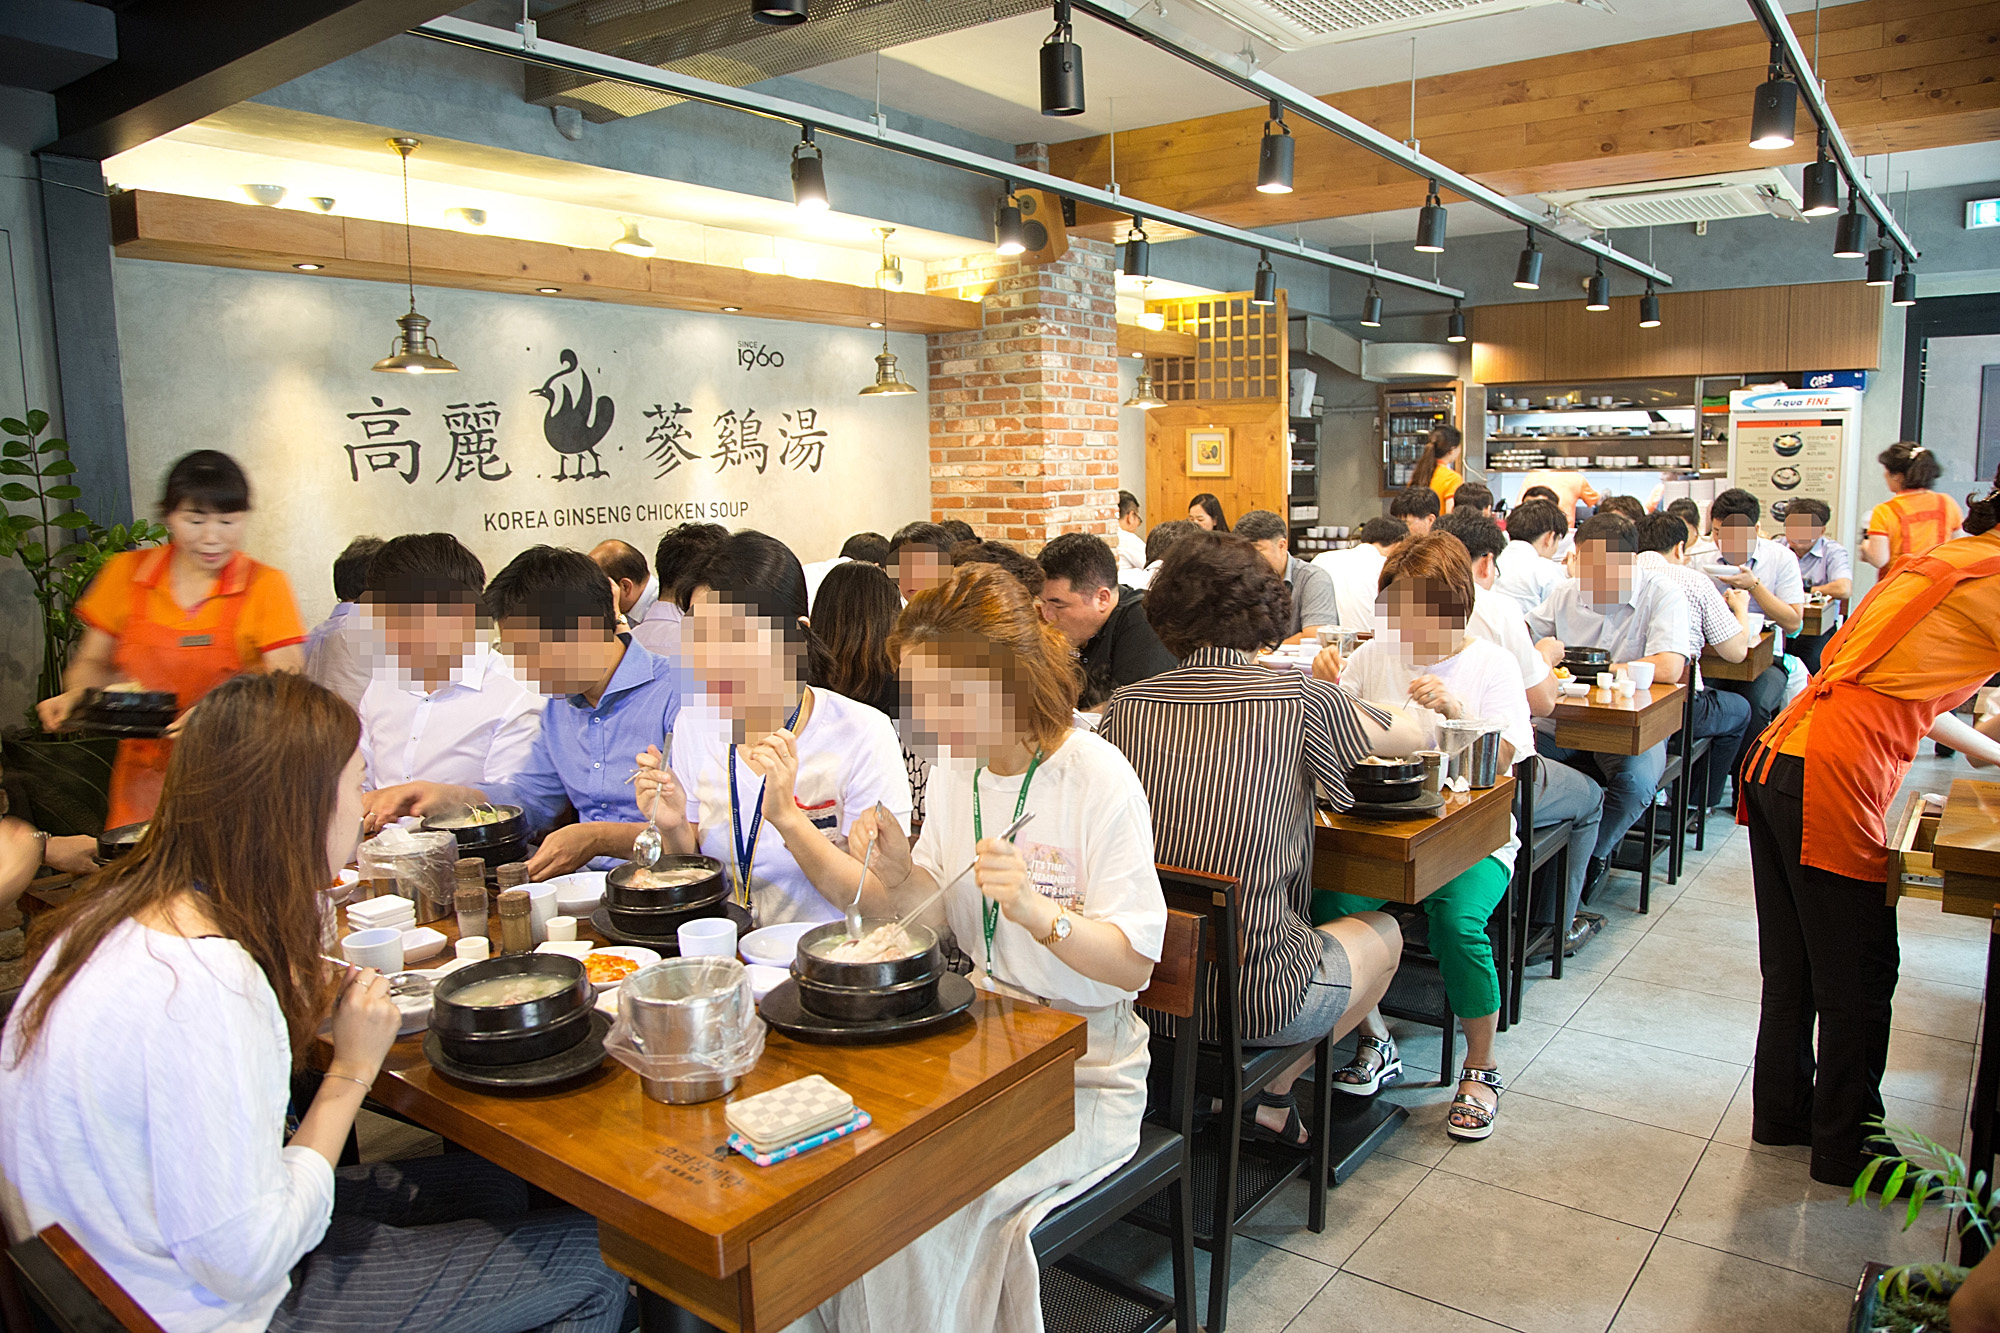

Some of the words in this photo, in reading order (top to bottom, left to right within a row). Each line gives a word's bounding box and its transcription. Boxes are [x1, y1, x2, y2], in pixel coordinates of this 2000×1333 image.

[737, 340, 758, 349] SINCE
[737, 344, 785, 371] 1960
[1809, 373, 1834, 388] Cass
[1806, 397, 1831, 406] FINE
[343, 396, 512, 485] 高麗
[484, 510, 549, 532] KOREA
[553, 505, 632, 527] GINSENG
[636, 502, 705, 521] CHICKEN
[710, 501, 750, 517] SOUP
[1047, 862, 1067, 873] TIME
[1032, 872, 1076, 884] REMEMBER
[1059, 887, 1076, 896] LIKE
